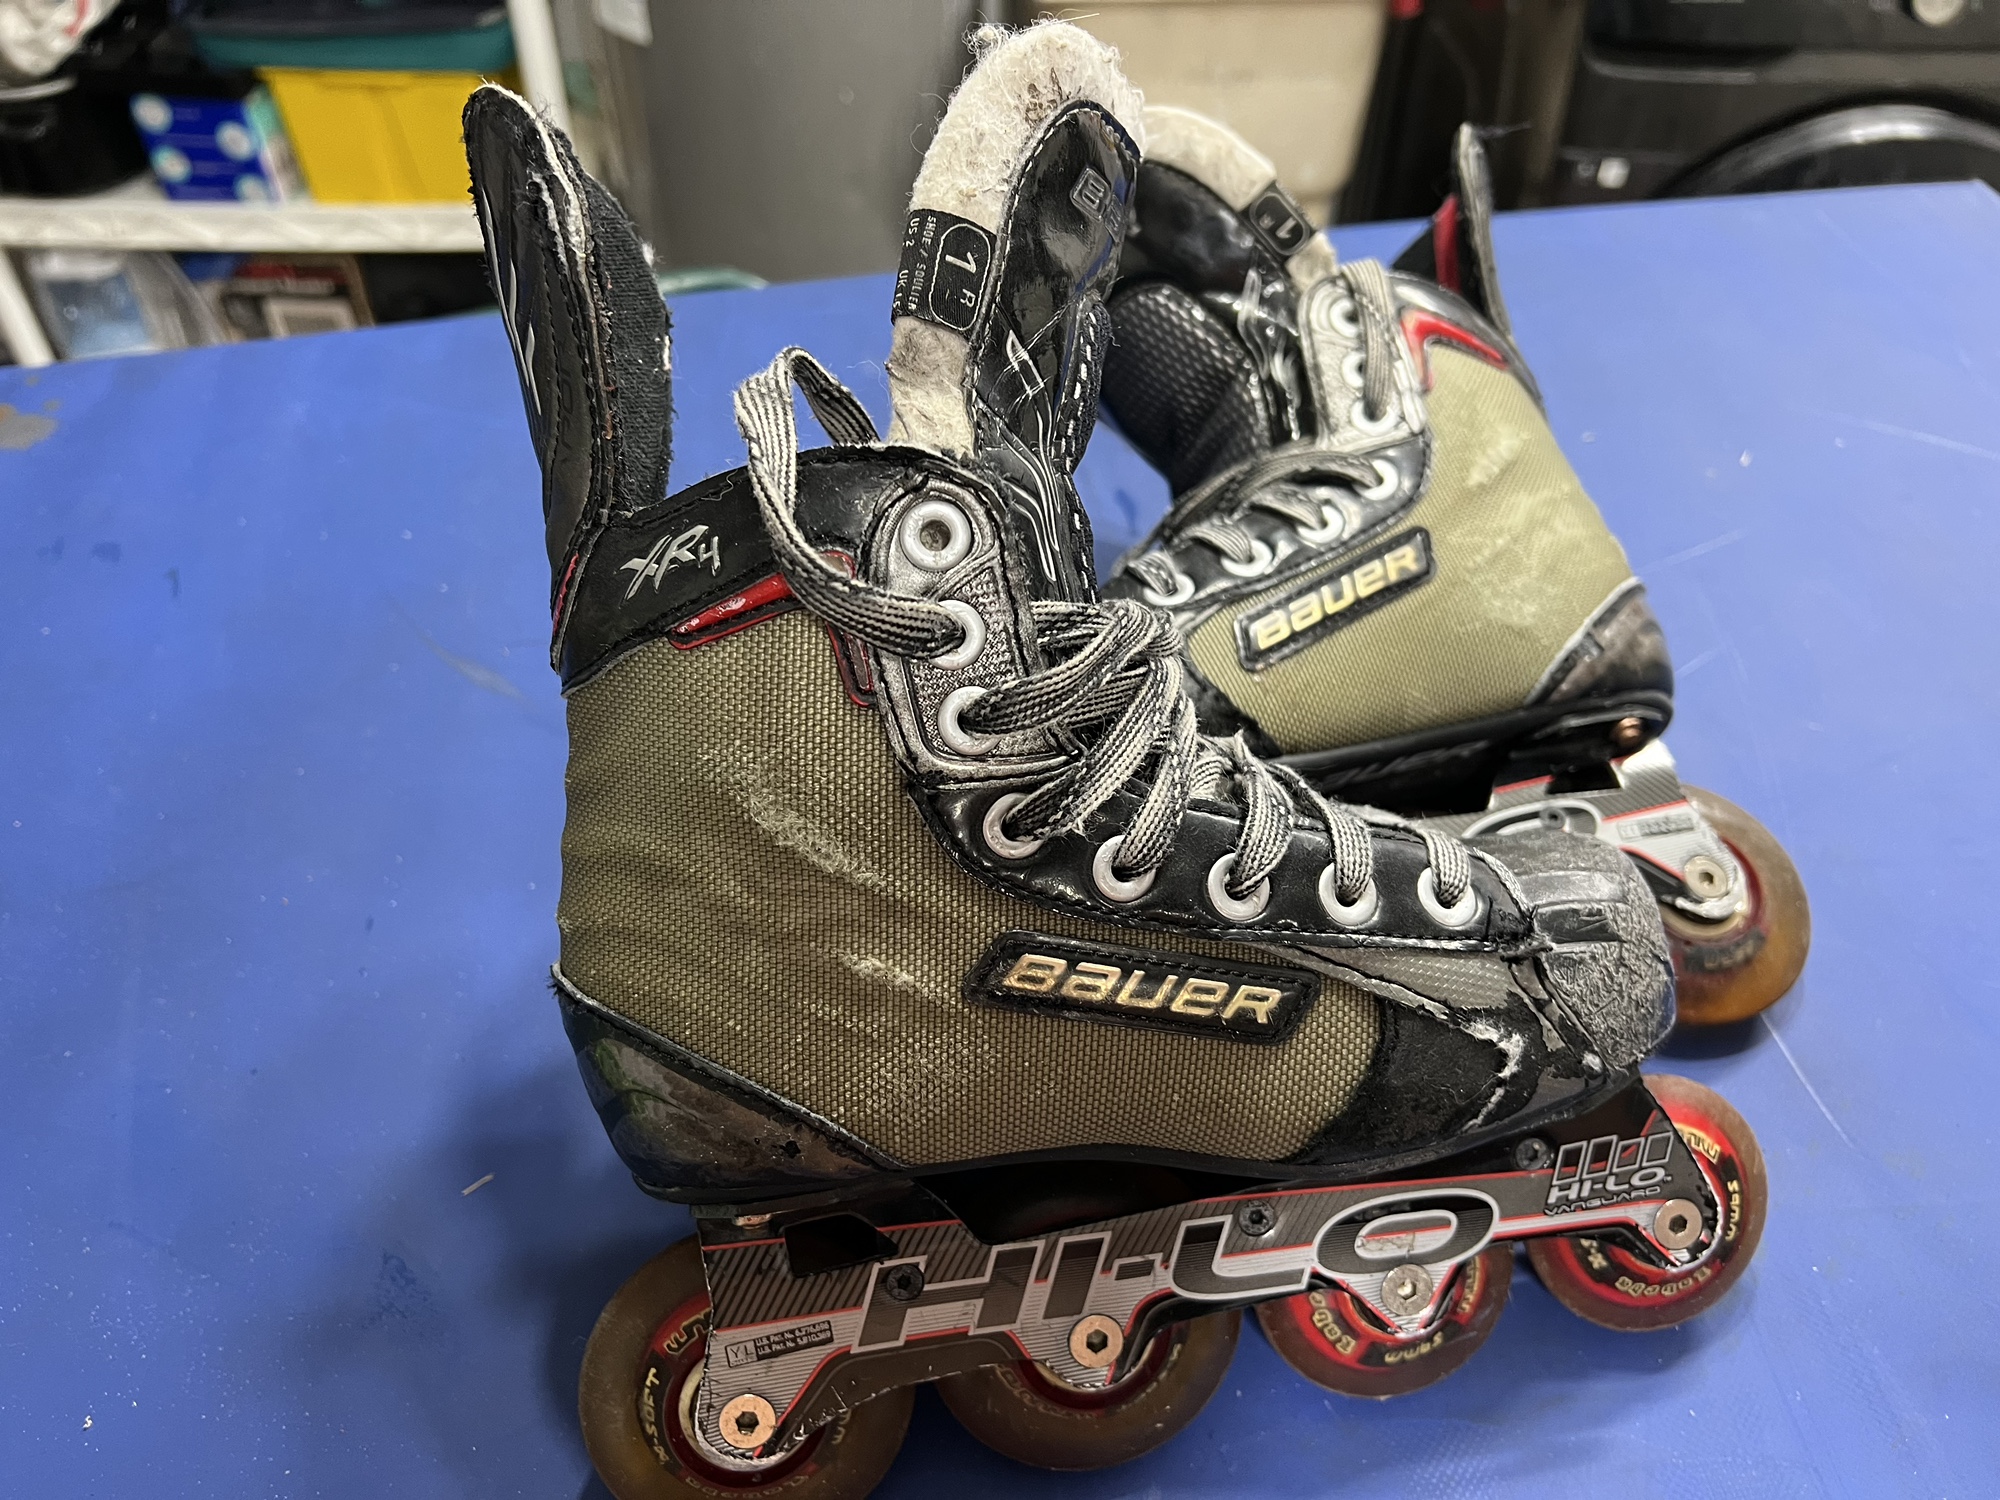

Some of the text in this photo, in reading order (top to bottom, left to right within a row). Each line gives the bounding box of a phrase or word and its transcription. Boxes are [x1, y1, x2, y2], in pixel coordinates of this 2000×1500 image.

[908, 217, 920, 235] US
[921, 215, 937, 245] SHOE
[897, 269, 909, 288] UK
[908, 262, 926, 311] SOULIER
[945, 251, 977, 307] 1 R
[850, 1187, 1500, 1354] HI-LO
